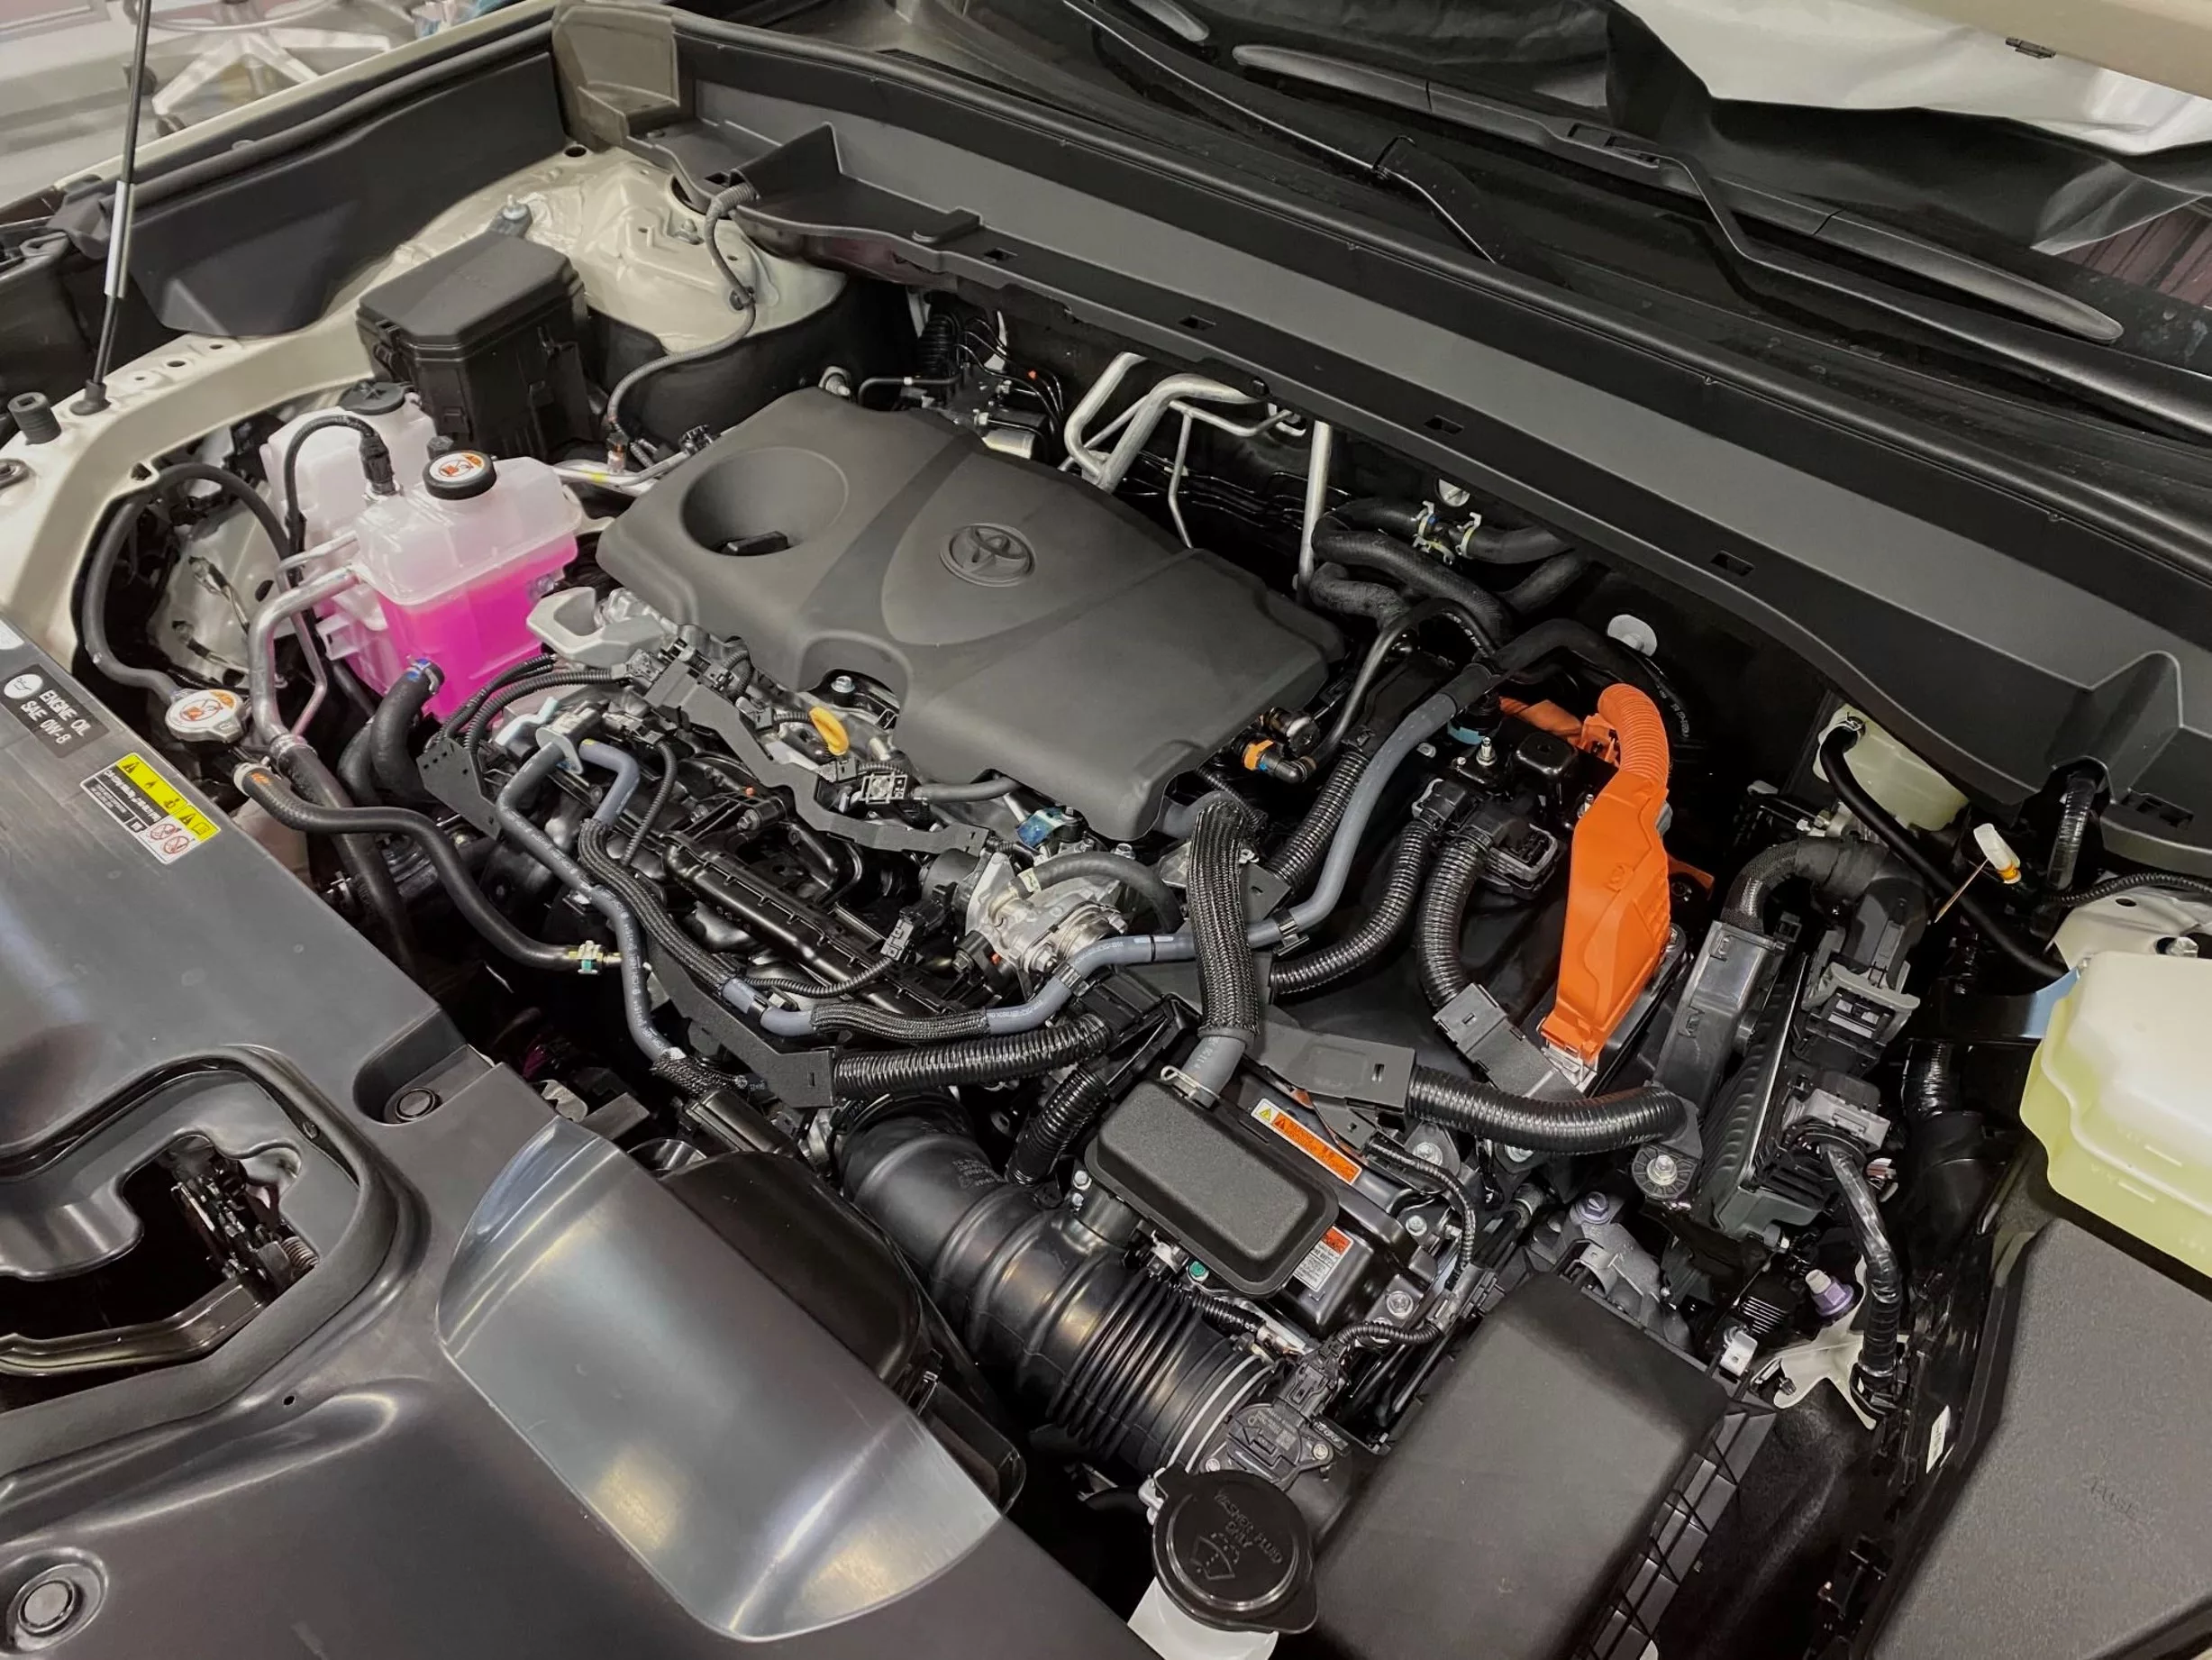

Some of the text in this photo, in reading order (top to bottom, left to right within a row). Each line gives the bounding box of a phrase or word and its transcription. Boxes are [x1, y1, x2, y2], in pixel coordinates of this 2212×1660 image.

[21, 700, 72, 744] SAE 0W-8
[40, 689, 92, 736] ENGINE OIL
[1215, 1488, 1283, 1564] WASHER FLUID
[1225, 1520, 1253, 1548] ONLY
